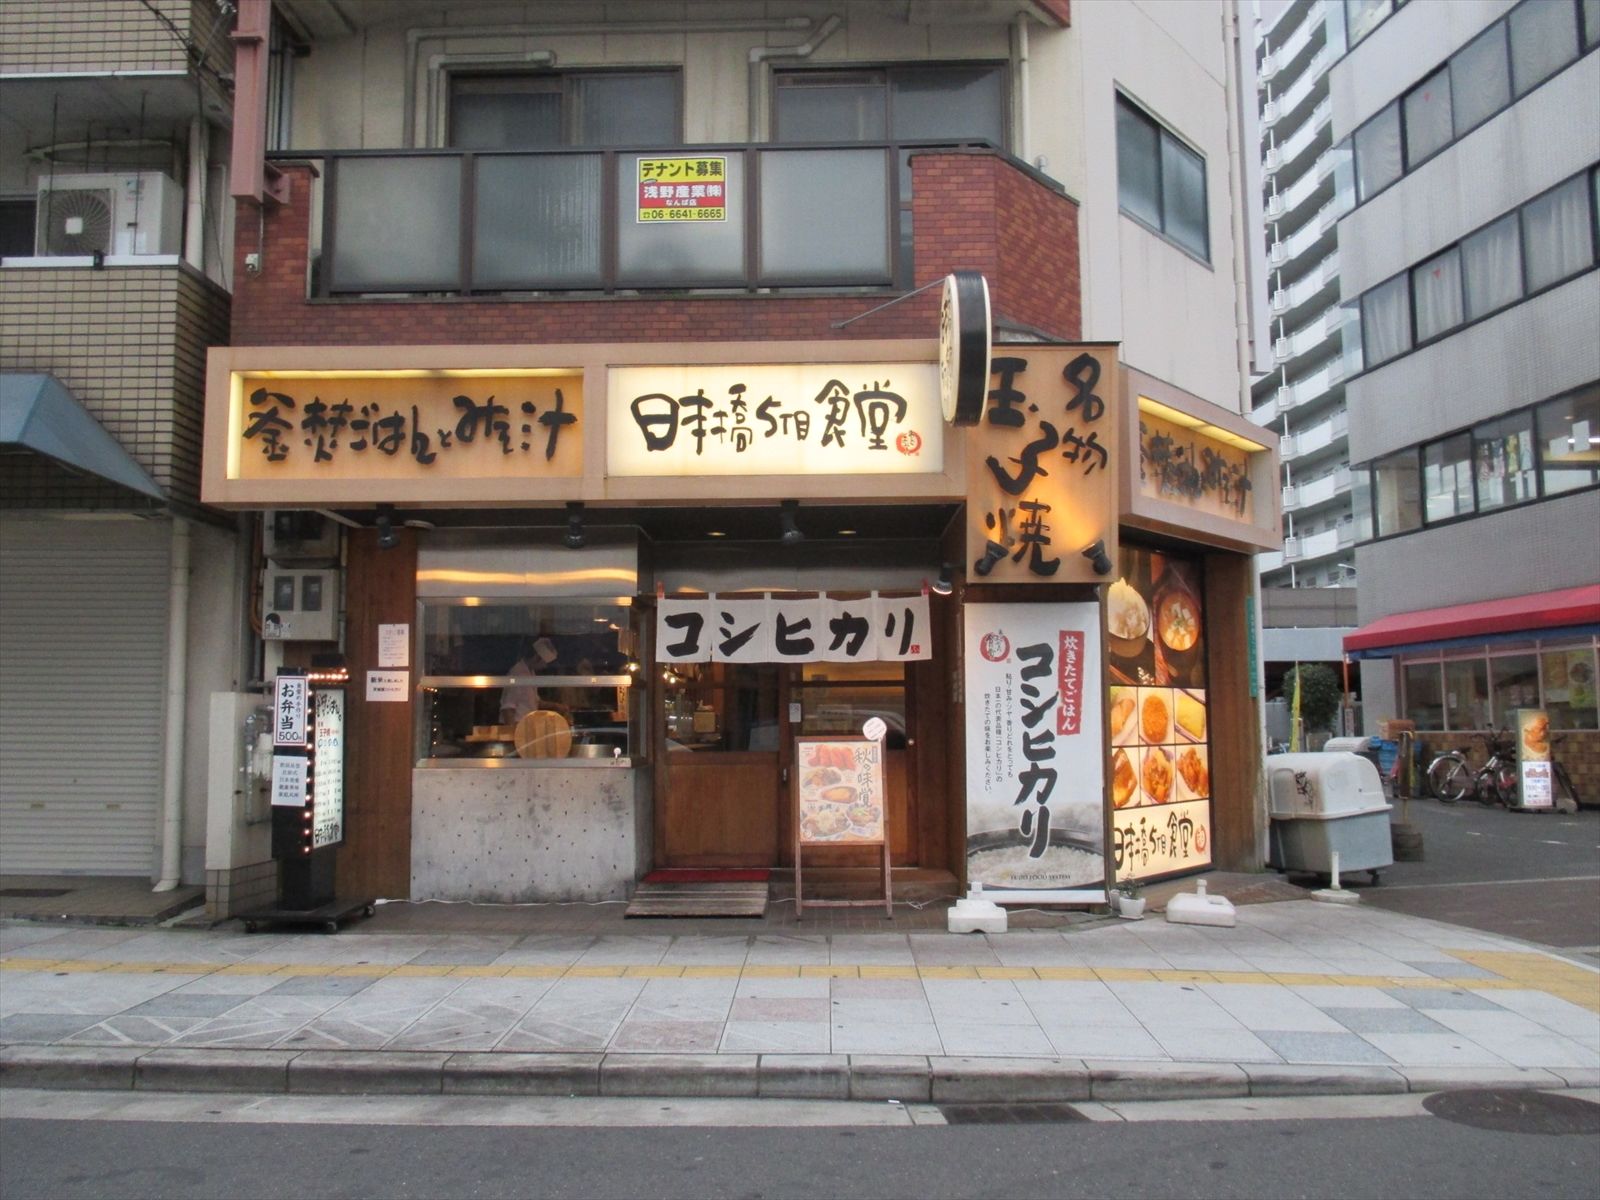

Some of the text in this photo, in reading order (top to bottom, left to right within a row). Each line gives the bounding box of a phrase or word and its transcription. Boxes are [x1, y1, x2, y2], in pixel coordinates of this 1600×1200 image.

[642, 161, 722, 177] テナント募集
[631, 379, 907, 455] 日本橋5丁目食堂
[1063, 352, 1108, 475] 名物
[664, 607, 914, 657] コシヒカリ
[280, 683, 295, 730] お弁当
[1062, 636, 1079, 731] 炊きたてごはん
[854, 747, 873, 807] 秋の味覚
[1013, 643, 1059, 858] コシヒカリ
